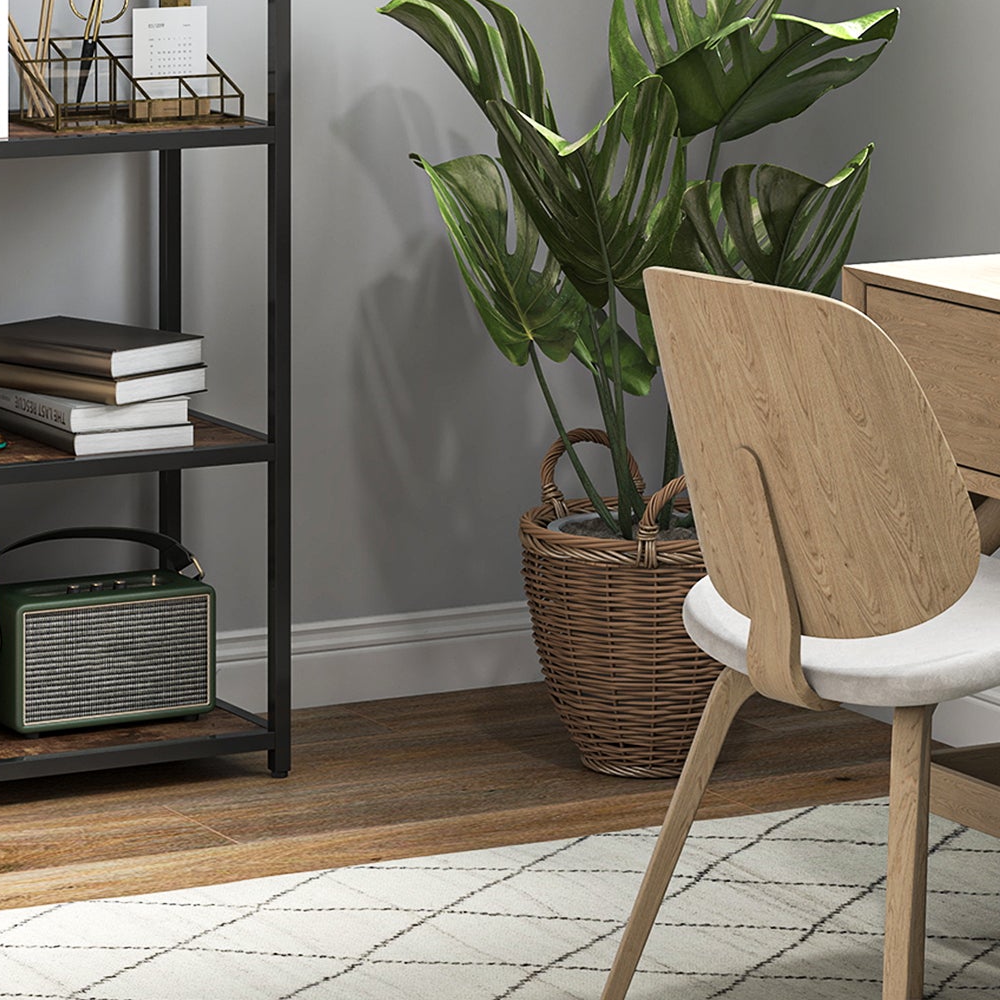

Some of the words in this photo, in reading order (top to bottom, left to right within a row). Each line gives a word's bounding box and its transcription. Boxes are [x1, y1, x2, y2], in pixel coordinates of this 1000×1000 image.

[14, 395, 37, 416] RESCUE
[38, 403, 53, 420] LAST
[53, 408, 66, 426] THE
